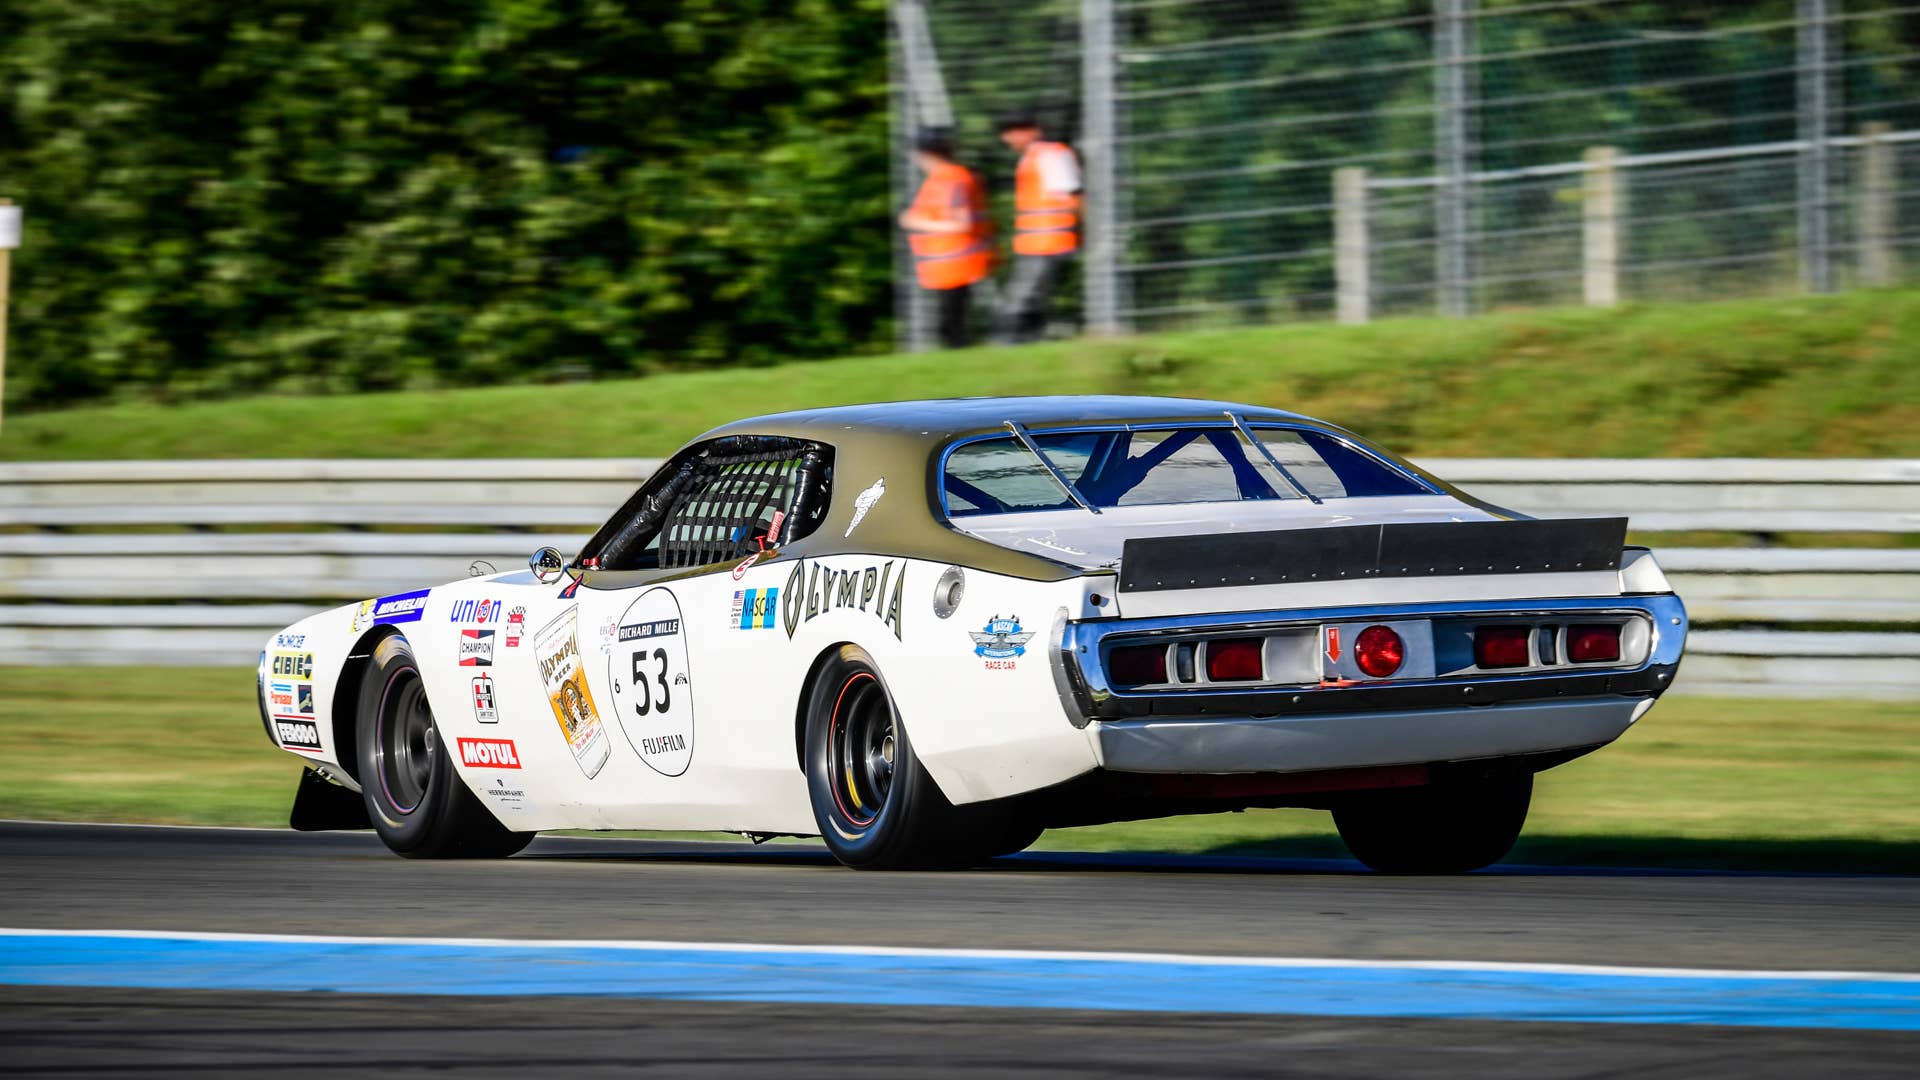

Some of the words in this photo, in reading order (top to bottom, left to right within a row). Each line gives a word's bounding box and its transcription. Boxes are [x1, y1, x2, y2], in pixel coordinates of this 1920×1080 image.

[376, 596, 429, 615] MICHELIN
[742, 596, 777, 617] NASCAR
[782, 555, 908, 642] OLYMPIA
[619, 624, 653, 640] RICHARD
[654, 620, 679, 634] MILLE
[461, 642, 492, 654] CHAMPION
[273, 654, 304, 675] CIBIÉ
[540, 632, 579, 687] OLYMPIA
[985, 660, 1002, 670] RACE
[1003, 660, 1017, 670] CAR
[554, 662, 572, 683] BEER
[632, 647, 671, 717] 53
[614, 677, 621, 694] 6
[276, 722, 318, 745] FERODO
[642, 733, 687, 755] FUJIFILM
[461, 741, 518, 766] MOTUL
